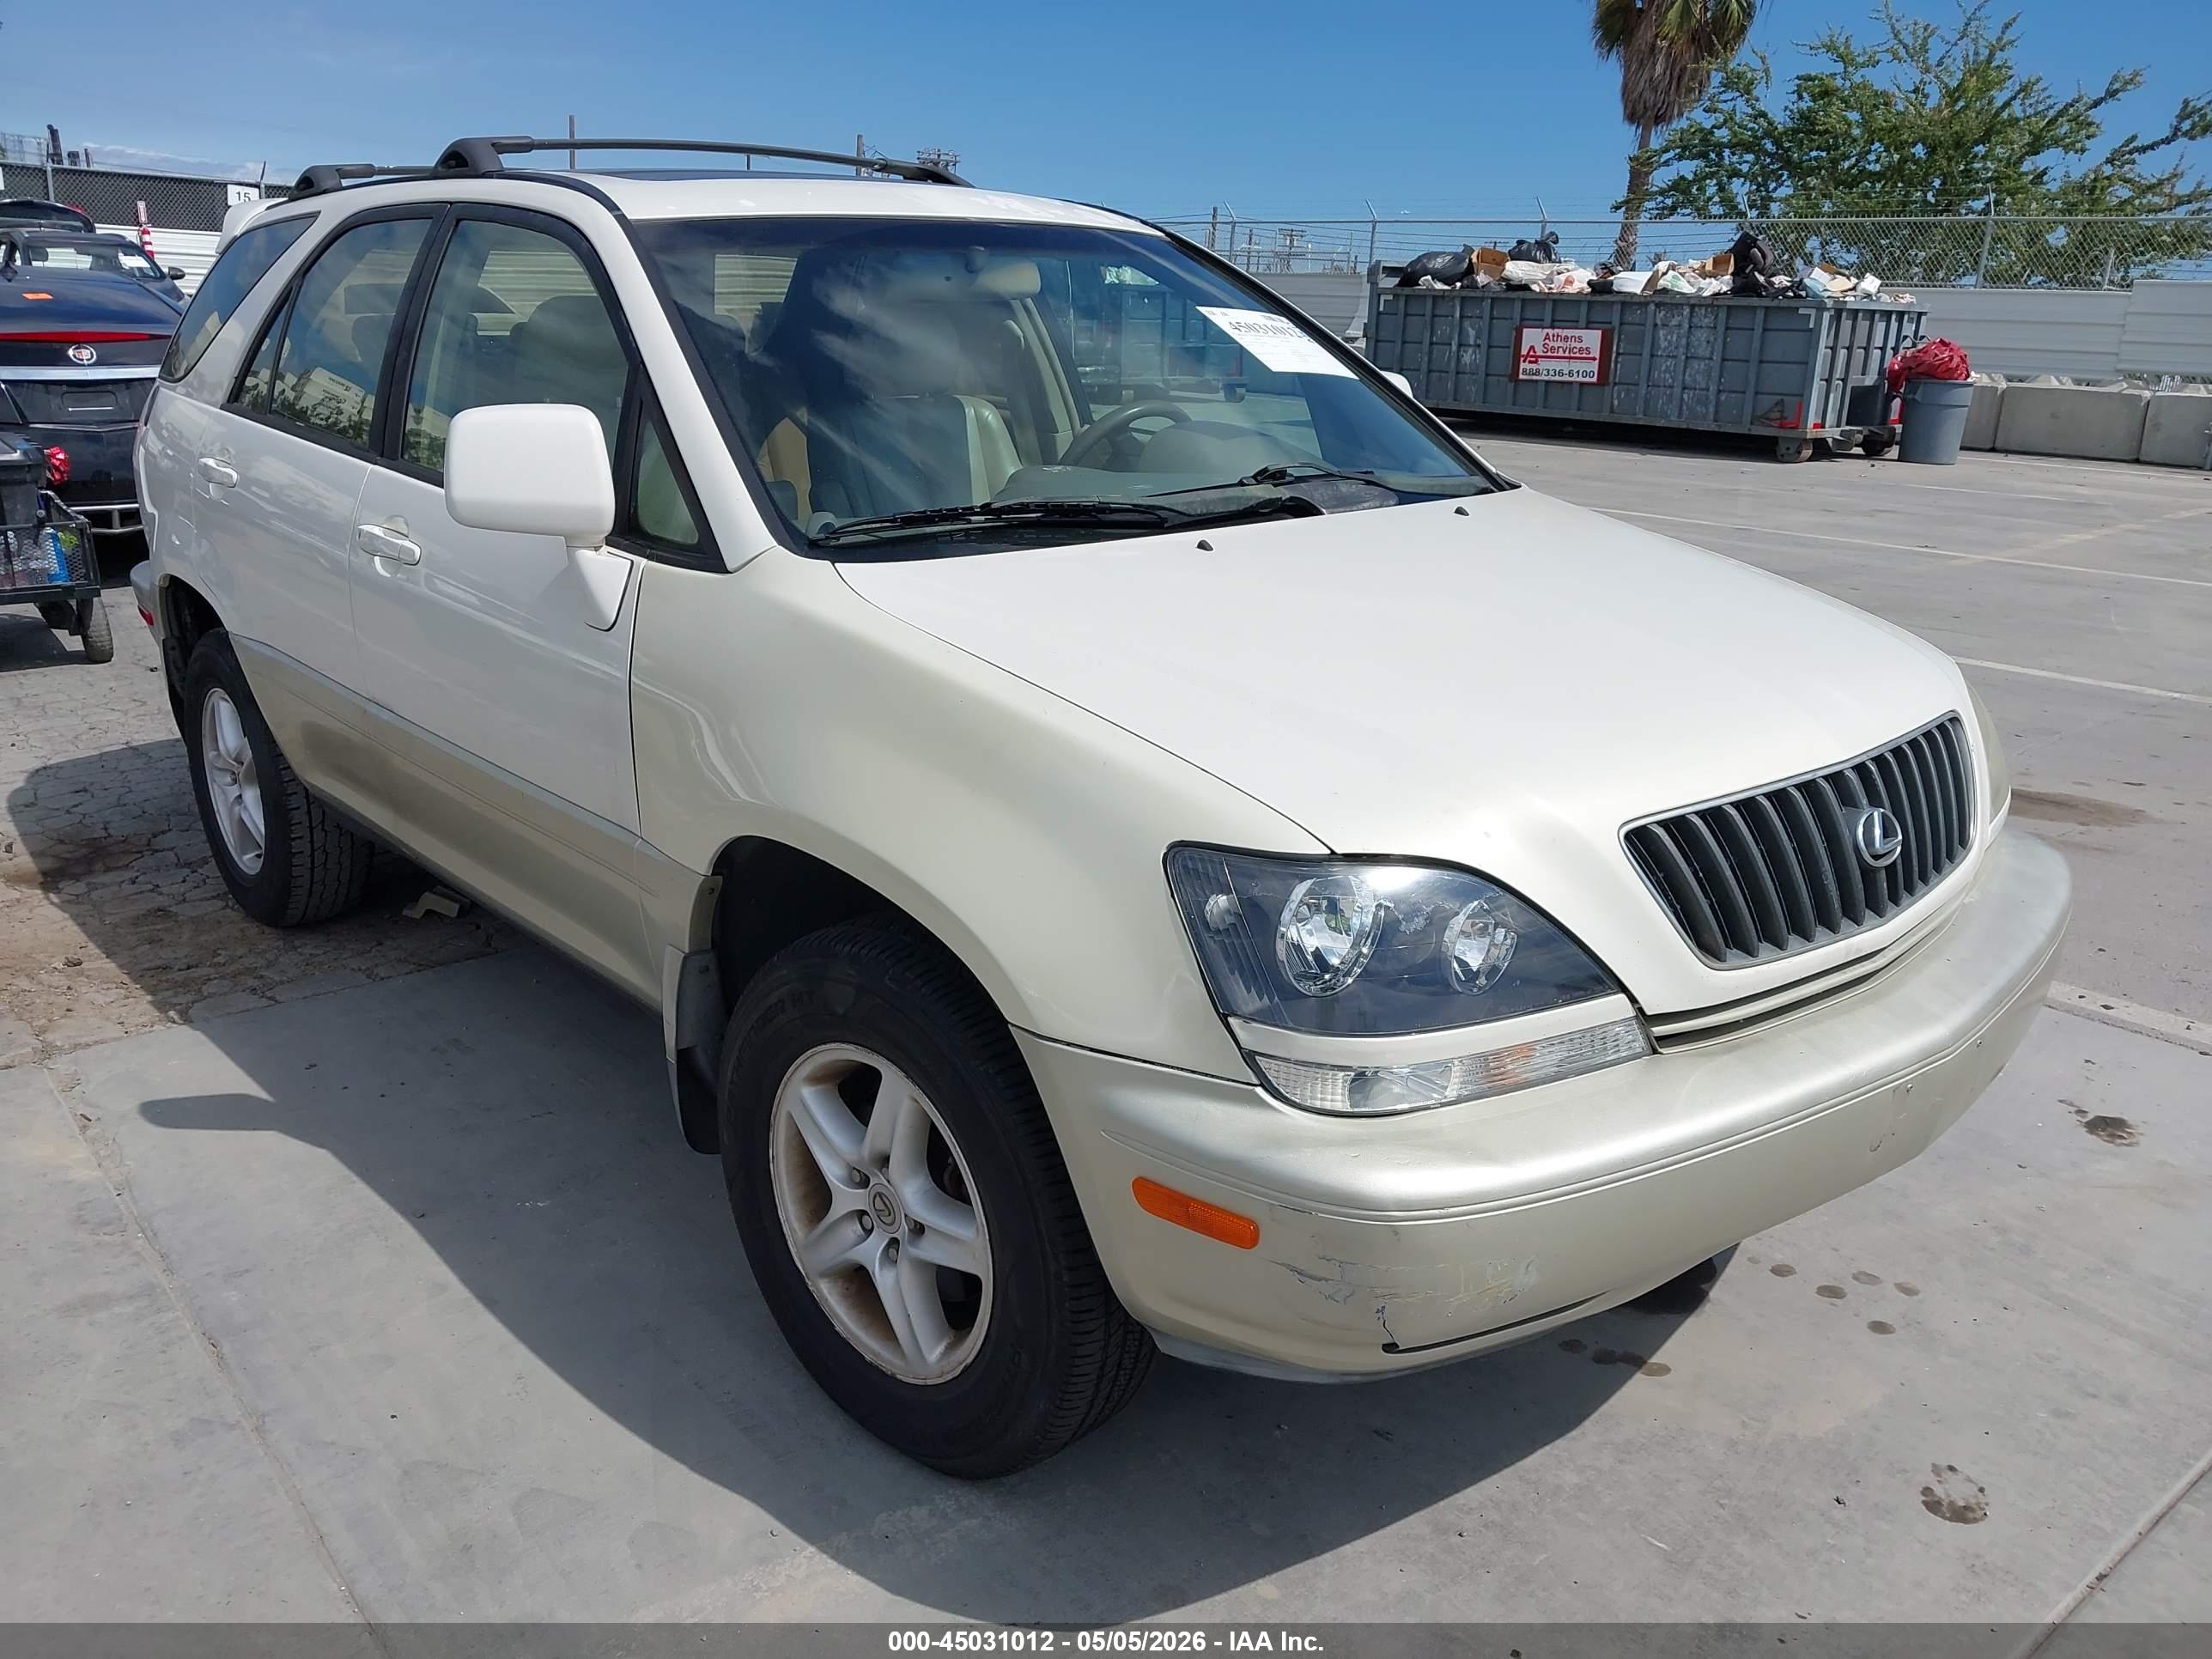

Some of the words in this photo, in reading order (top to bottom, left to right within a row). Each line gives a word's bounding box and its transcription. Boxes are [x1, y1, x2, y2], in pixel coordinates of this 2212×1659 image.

[235, 191, 251, 203] 15
[1228, 320, 1304, 338] 45031012
[1542, 332, 1583, 343] Athens
[1541, 343, 1591, 356] Services
[1521, 367, 1595, 379] 888/336-6100
